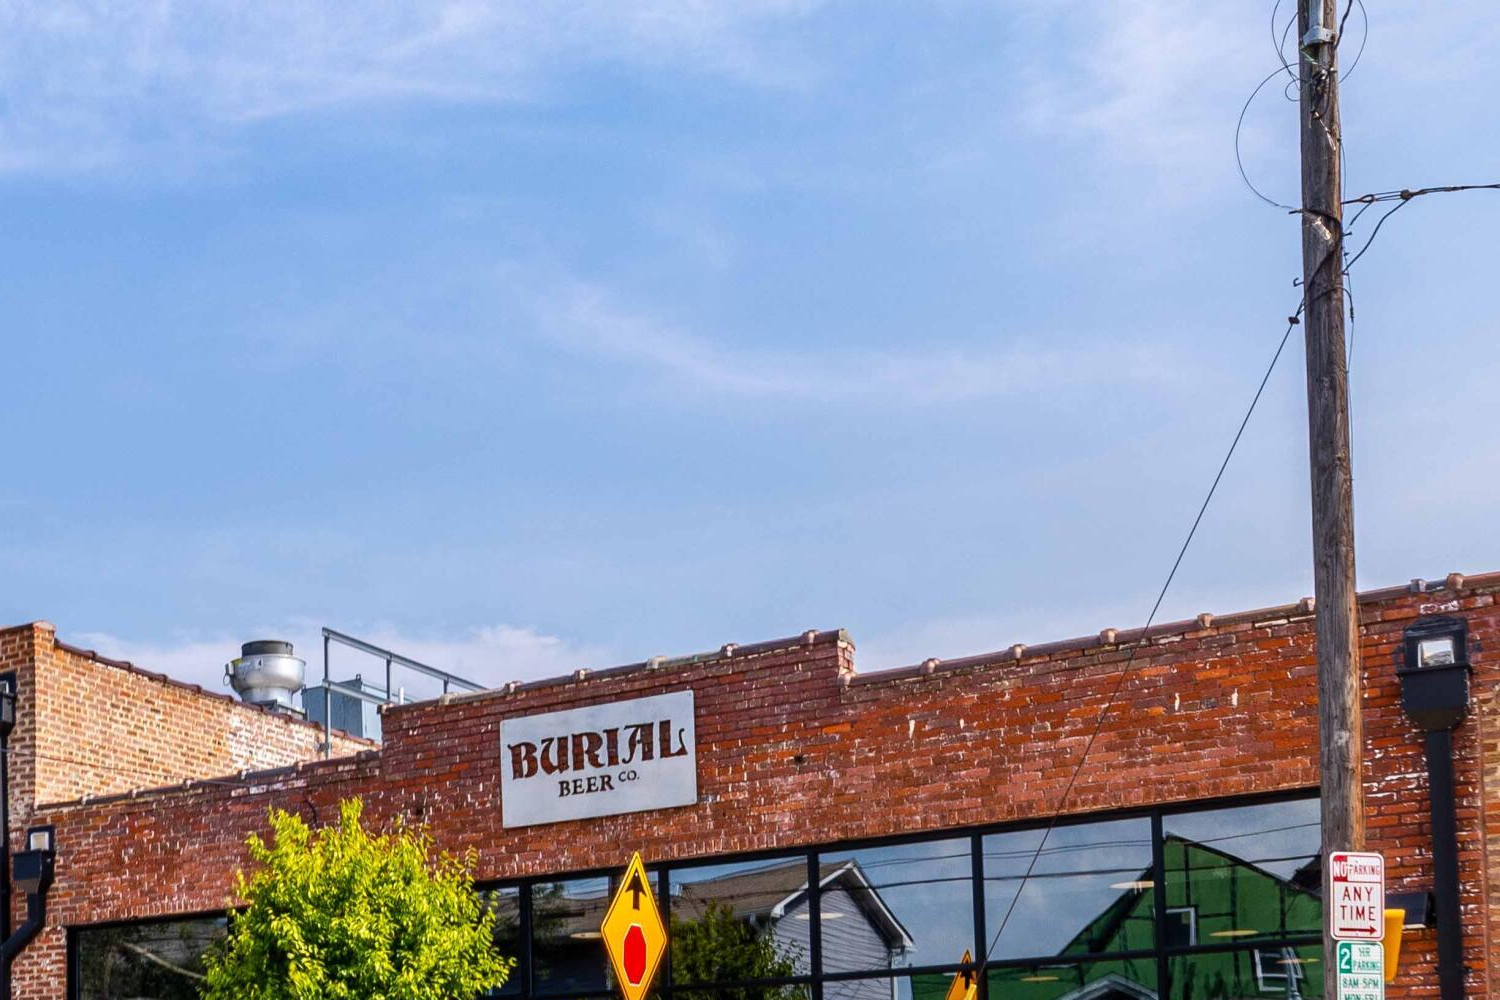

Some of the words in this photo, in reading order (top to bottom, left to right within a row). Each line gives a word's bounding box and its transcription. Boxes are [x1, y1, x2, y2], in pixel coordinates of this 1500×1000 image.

[507, 719, 689, 780] BURIAL
[558, 774, 615, 798] BEER
[618, 769, 640, 783] CO.
[1333, 860, 1348, 878] NO
[1348, 864, 1381, 875] PARKING
[1342, 886, 1373, 902] ANY
[1340, 905, 1376, 921] TIME
[1340, 947, 1351, 970] 2
[1353, 960, 1381, 971] PARKING
